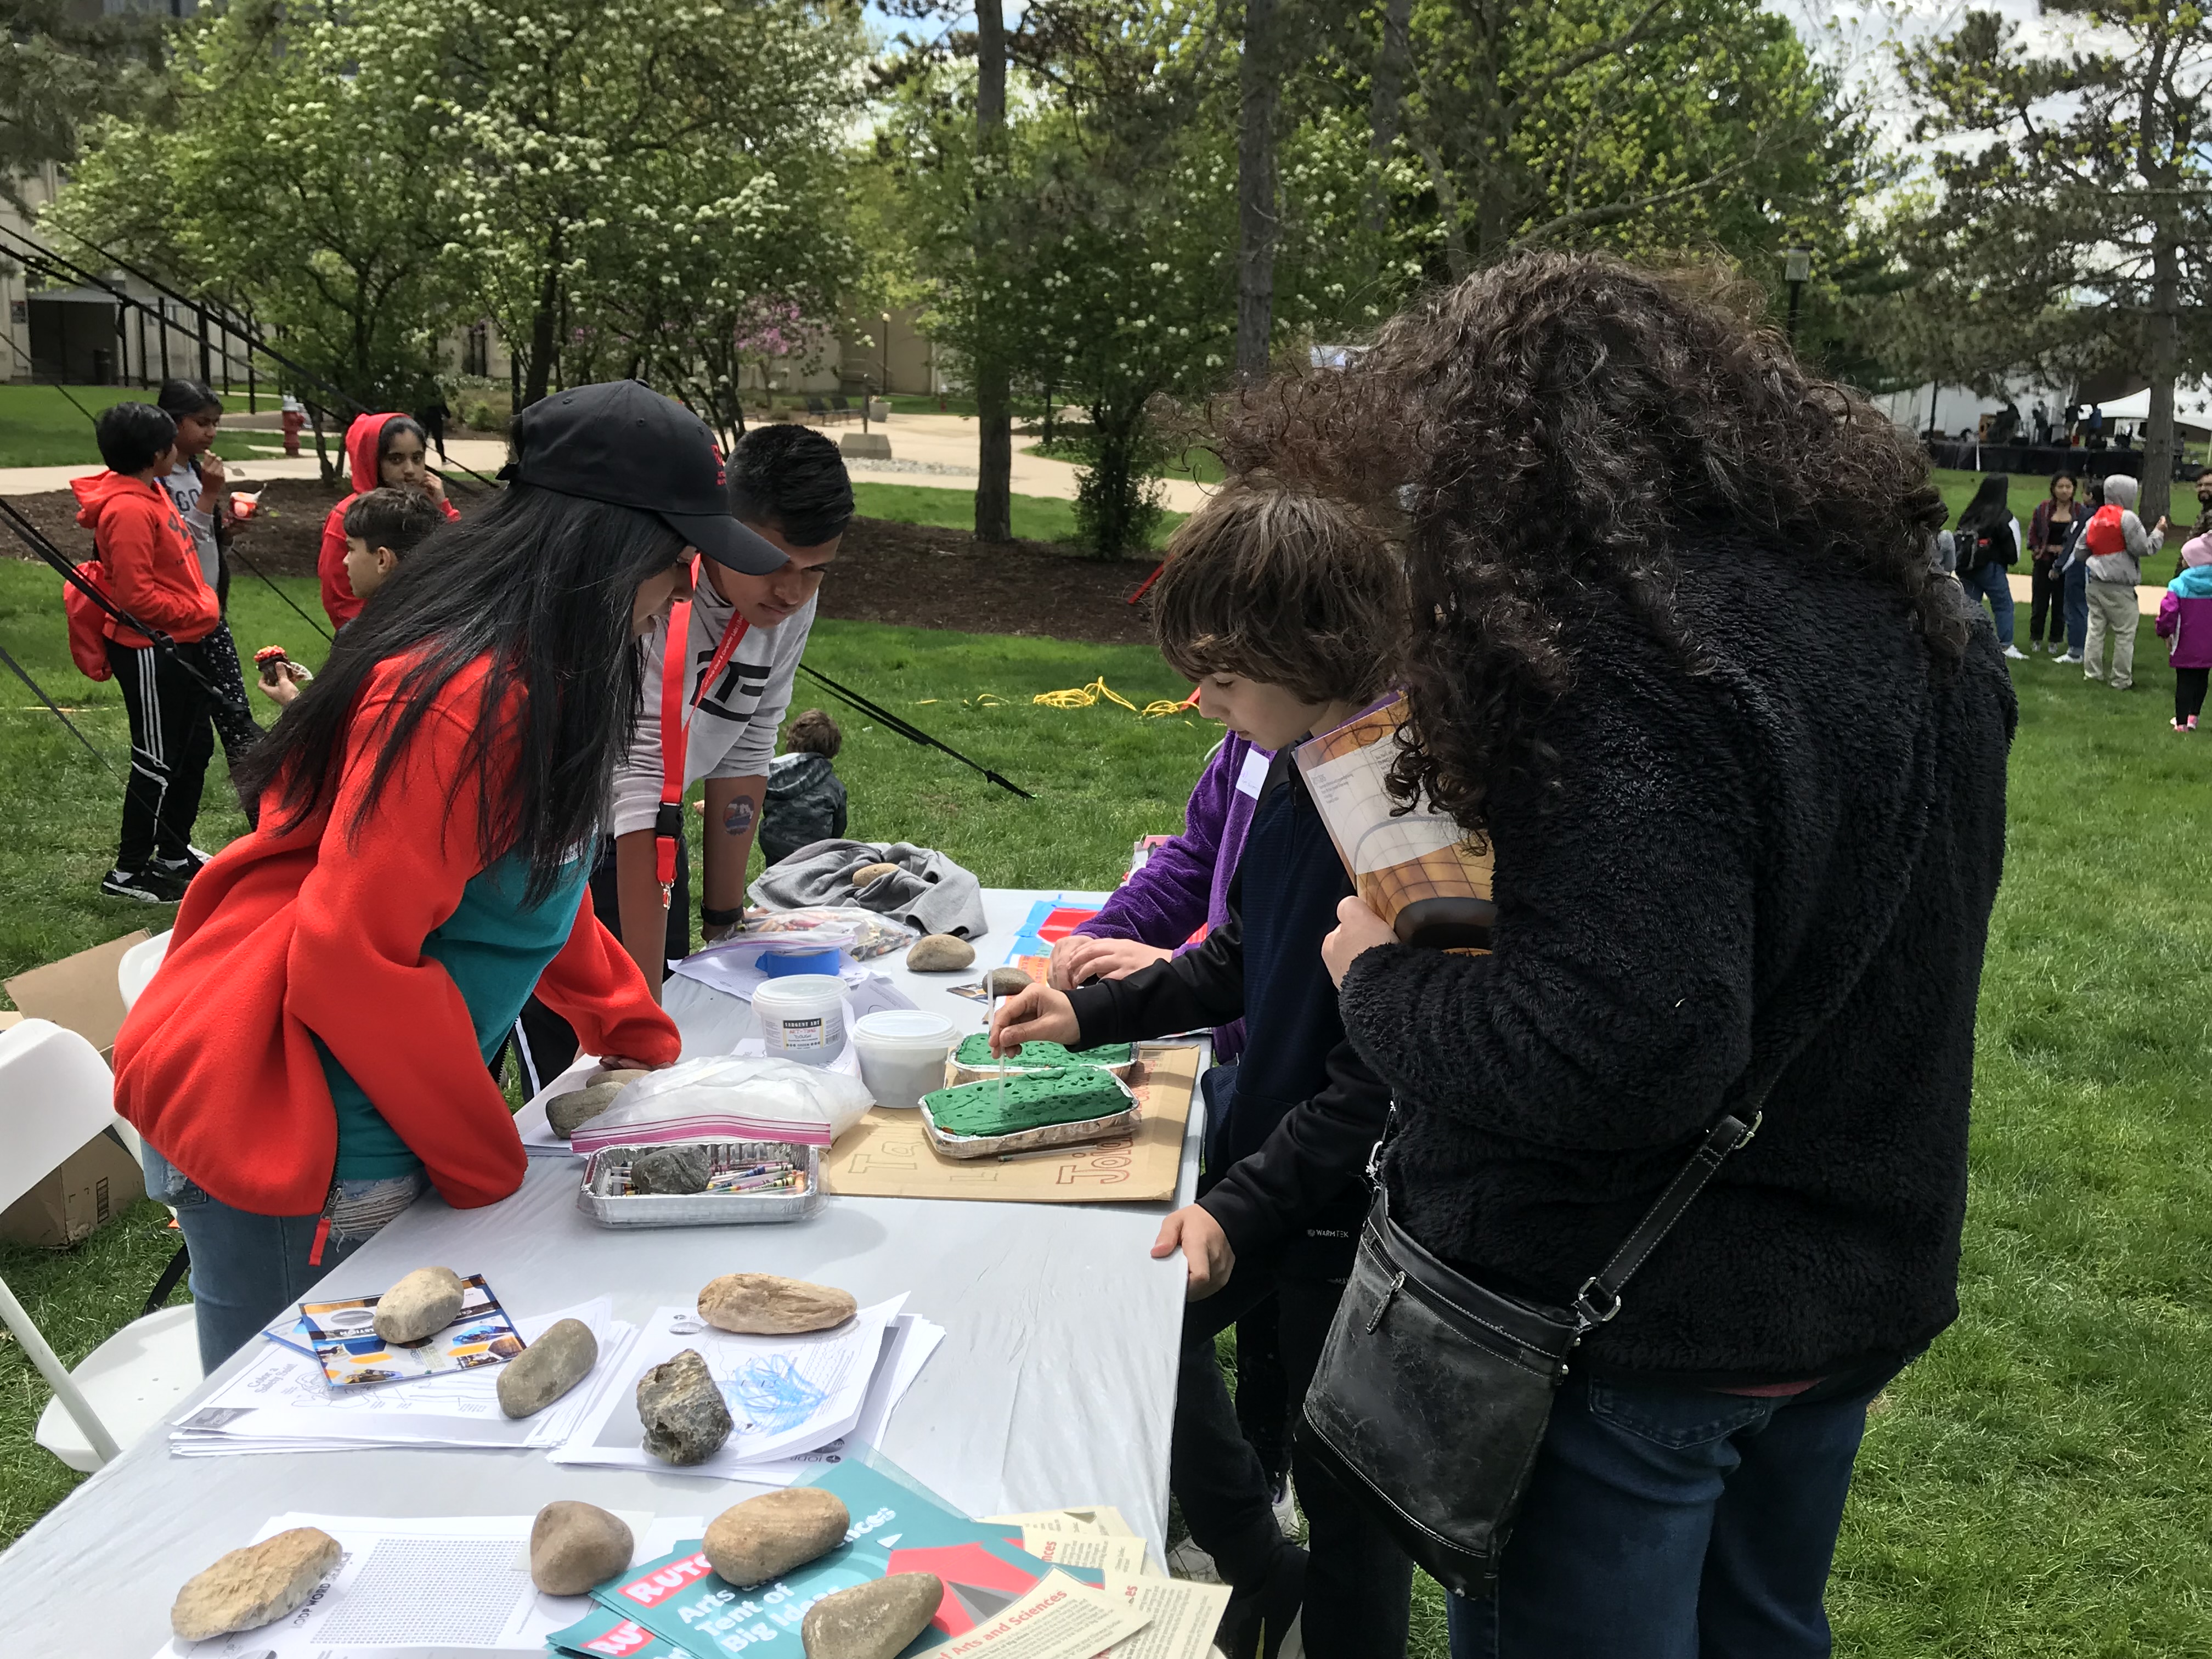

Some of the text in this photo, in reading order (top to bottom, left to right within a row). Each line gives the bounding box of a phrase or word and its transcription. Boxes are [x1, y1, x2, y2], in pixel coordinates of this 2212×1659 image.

[306, 1583, 331, 1606] WORD
[678, 1589, 736, 1624] Arts
[694, 1600, 764, 1637] Tent
[951, 1639, 983, 1655] Arts
[983, 1622, 1011, 1641] and
[1008, 1590, 1068, 1626] Sciences
[720, 1622, 778, 1652] Big
